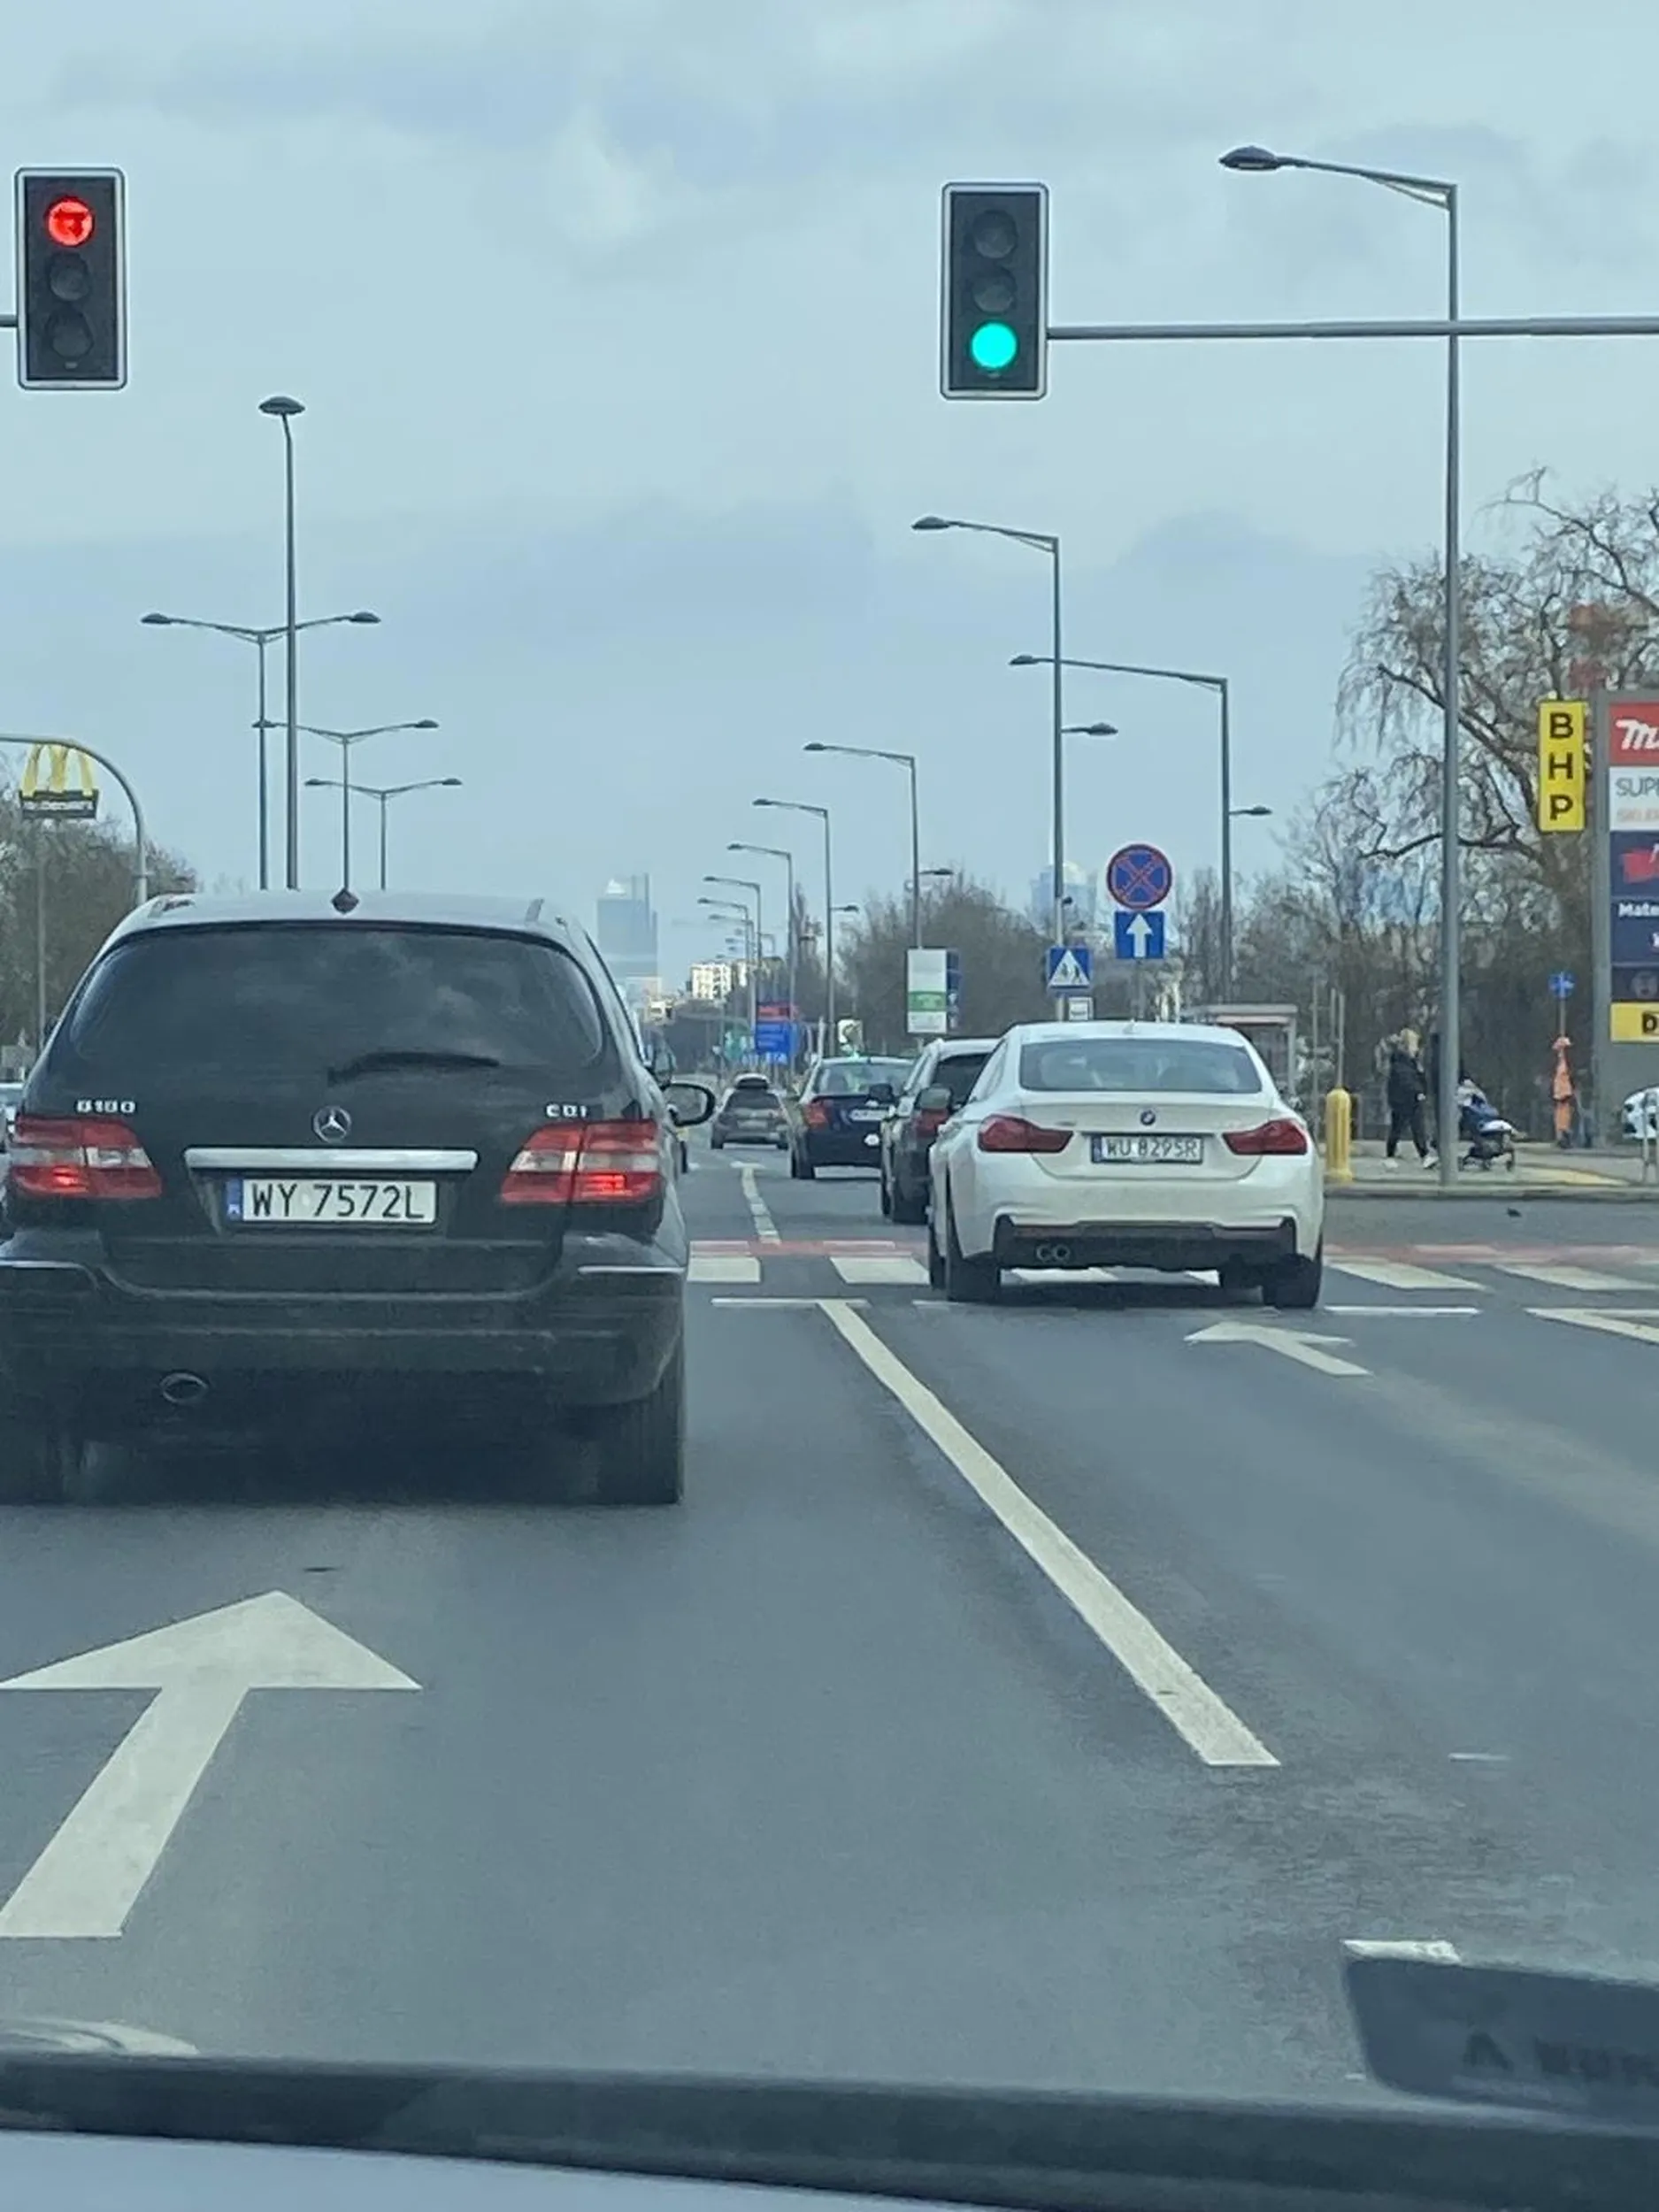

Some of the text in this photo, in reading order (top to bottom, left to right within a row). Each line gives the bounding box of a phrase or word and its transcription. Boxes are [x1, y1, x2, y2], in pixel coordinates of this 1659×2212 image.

[1616, 718, 1659, 750] M
[1548, 711, 1574, 821] BHP
[252, 1183, 425, 1218] WY 7572L
